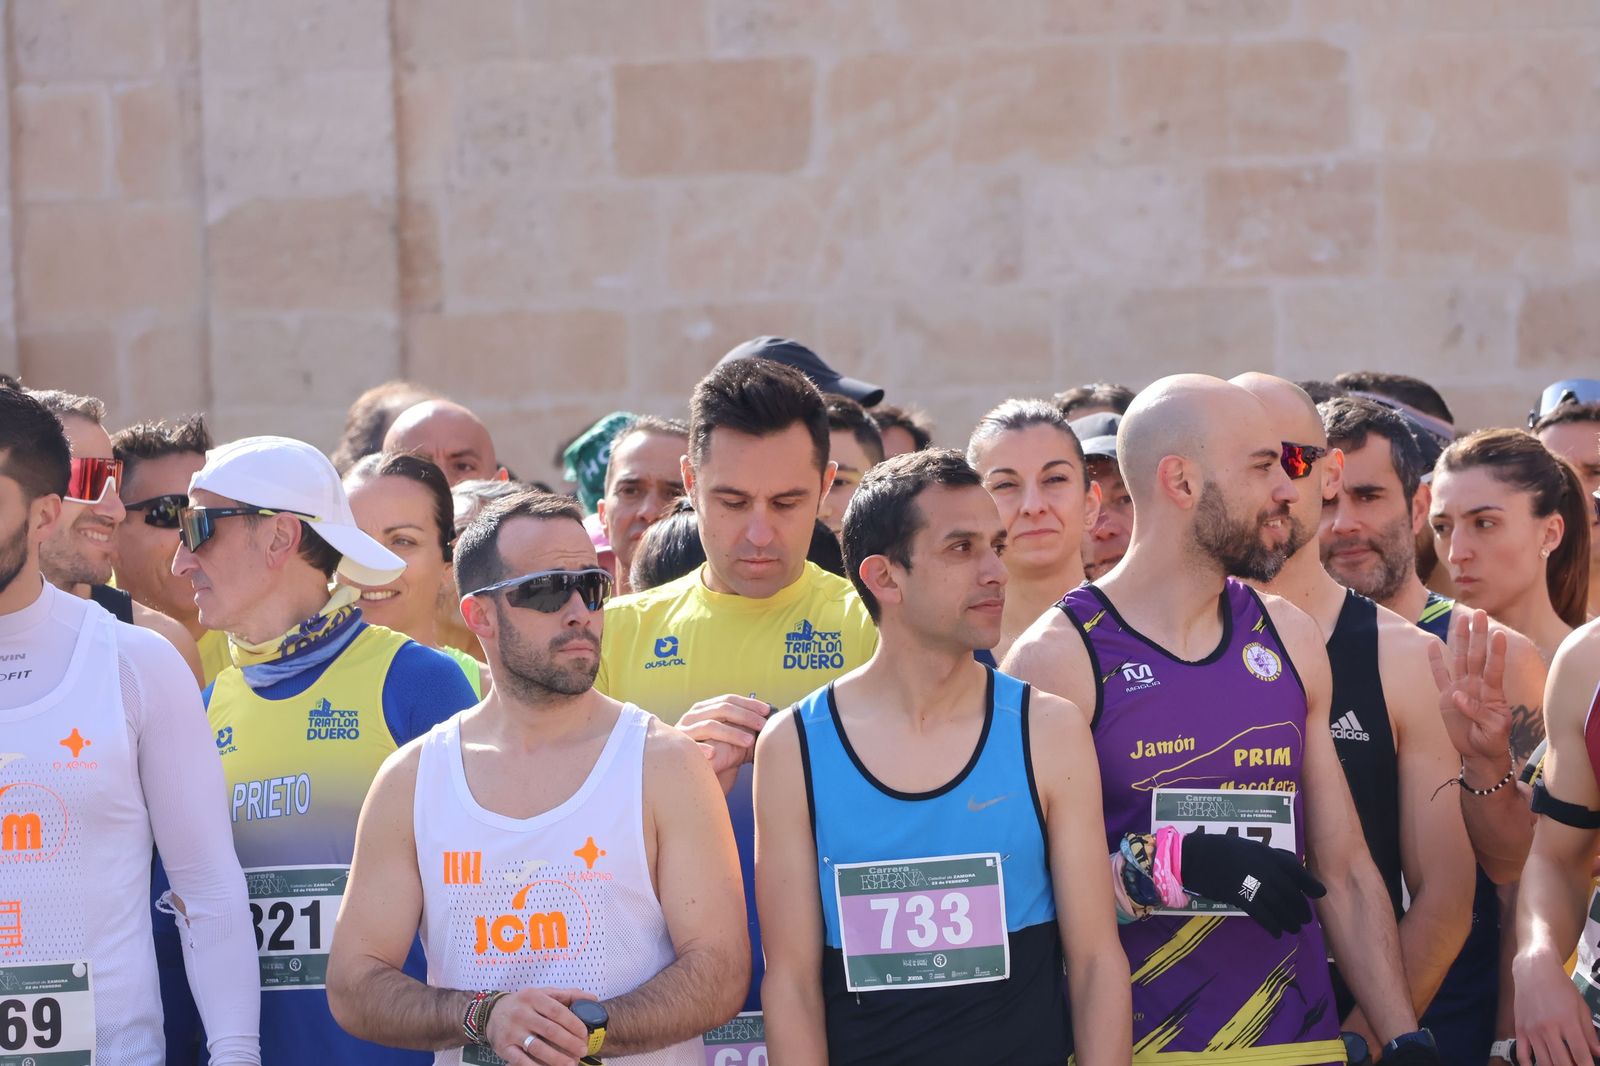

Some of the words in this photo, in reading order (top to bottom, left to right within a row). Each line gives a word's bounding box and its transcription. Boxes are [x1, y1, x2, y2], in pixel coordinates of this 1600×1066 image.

[785, 640, 842, 654] TRIATLON
[784, 652, 844, 670] DUERO
[308, 717, 360, 729] TRIATLON
[307, 727, 360, 741] DUERO
[1129, 734, 1195, 760] Jamón
[1234, 747, 1292, 768] PRIM
[232, 773, 310, 822] PRIETO
[1185, 794, 1223, 802] Carrera
[869, 866, 910, 874] Carrera
[870, 892, 974, 950] 733
[0, 997, 62, 1051] 69
